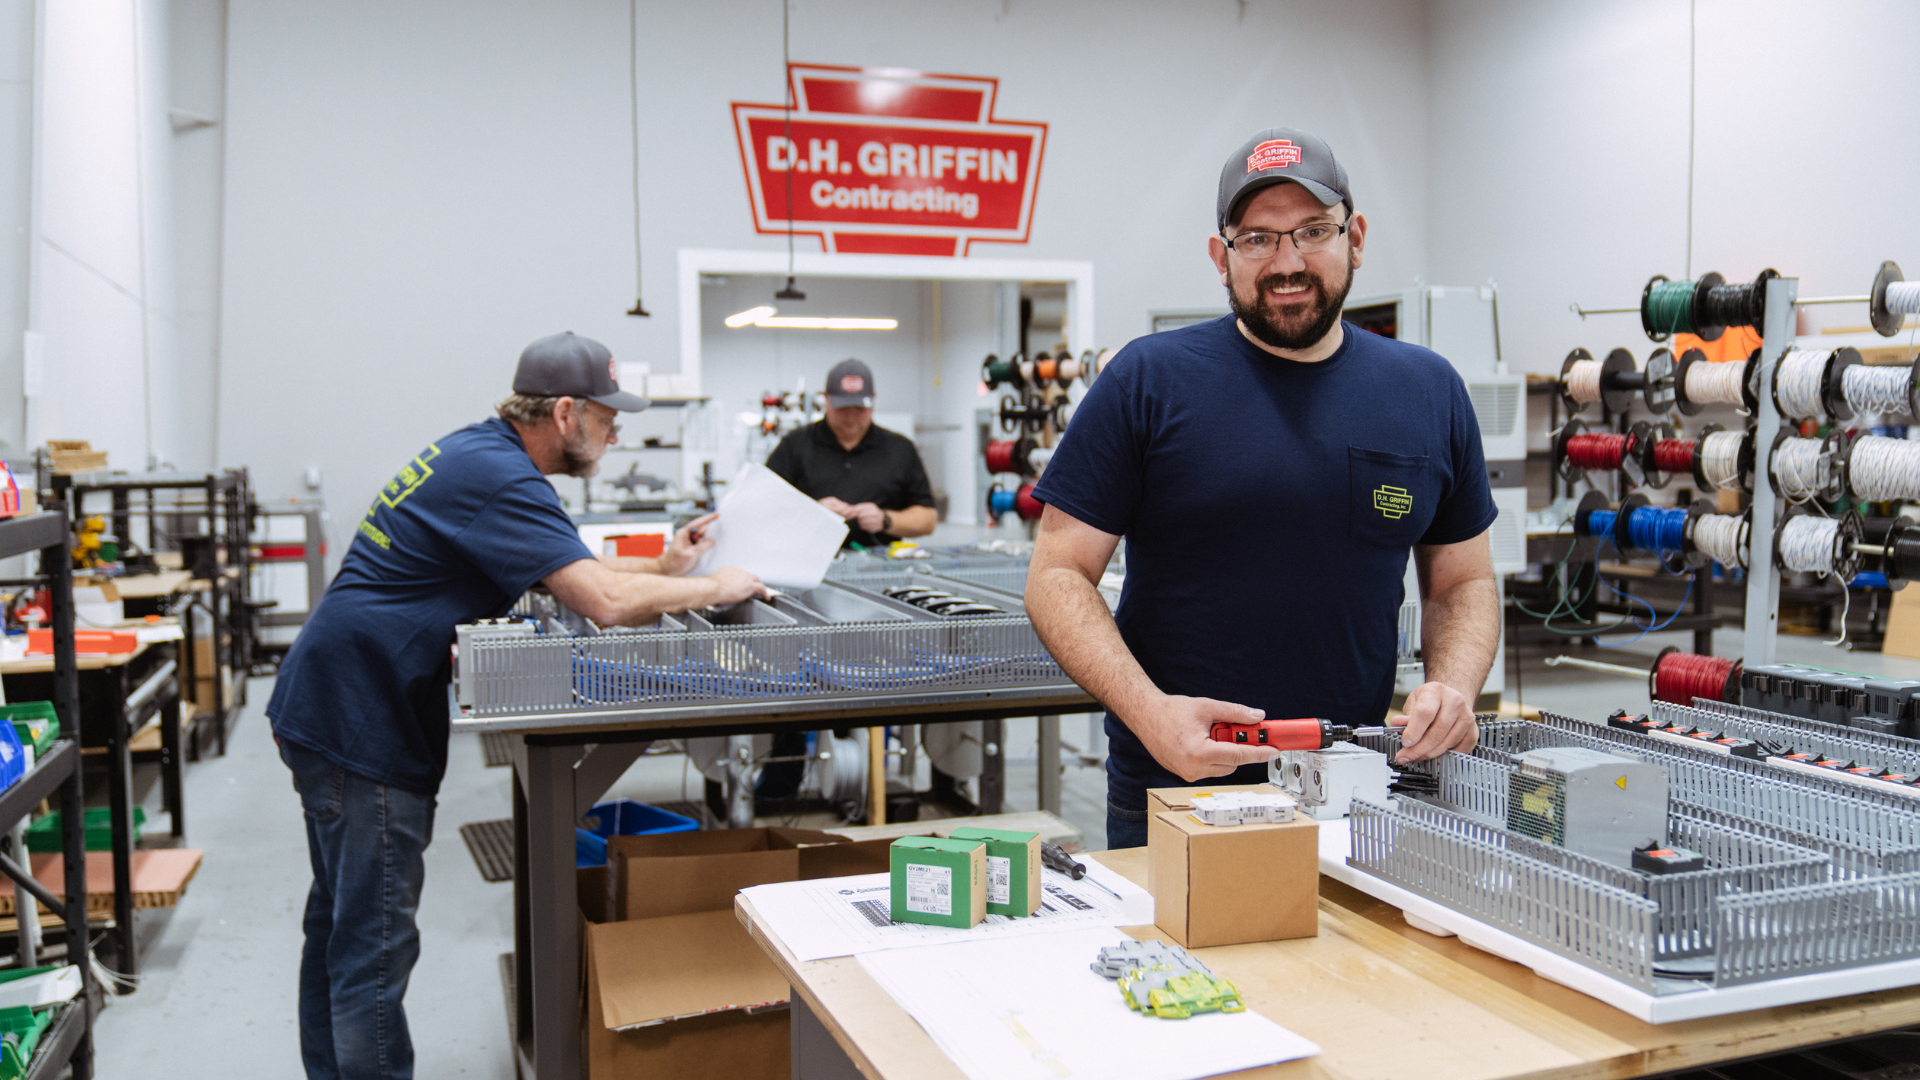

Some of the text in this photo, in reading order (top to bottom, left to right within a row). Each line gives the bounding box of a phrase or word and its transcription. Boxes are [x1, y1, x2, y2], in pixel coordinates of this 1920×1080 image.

[766, 135, 1018, 183] D.H. GRIFFIN
[1252, 154, 1295, 166] Contracting
[810, 180, 980, 219] Contracting
[1389, 496, 1409, 504] GRIFFIN
